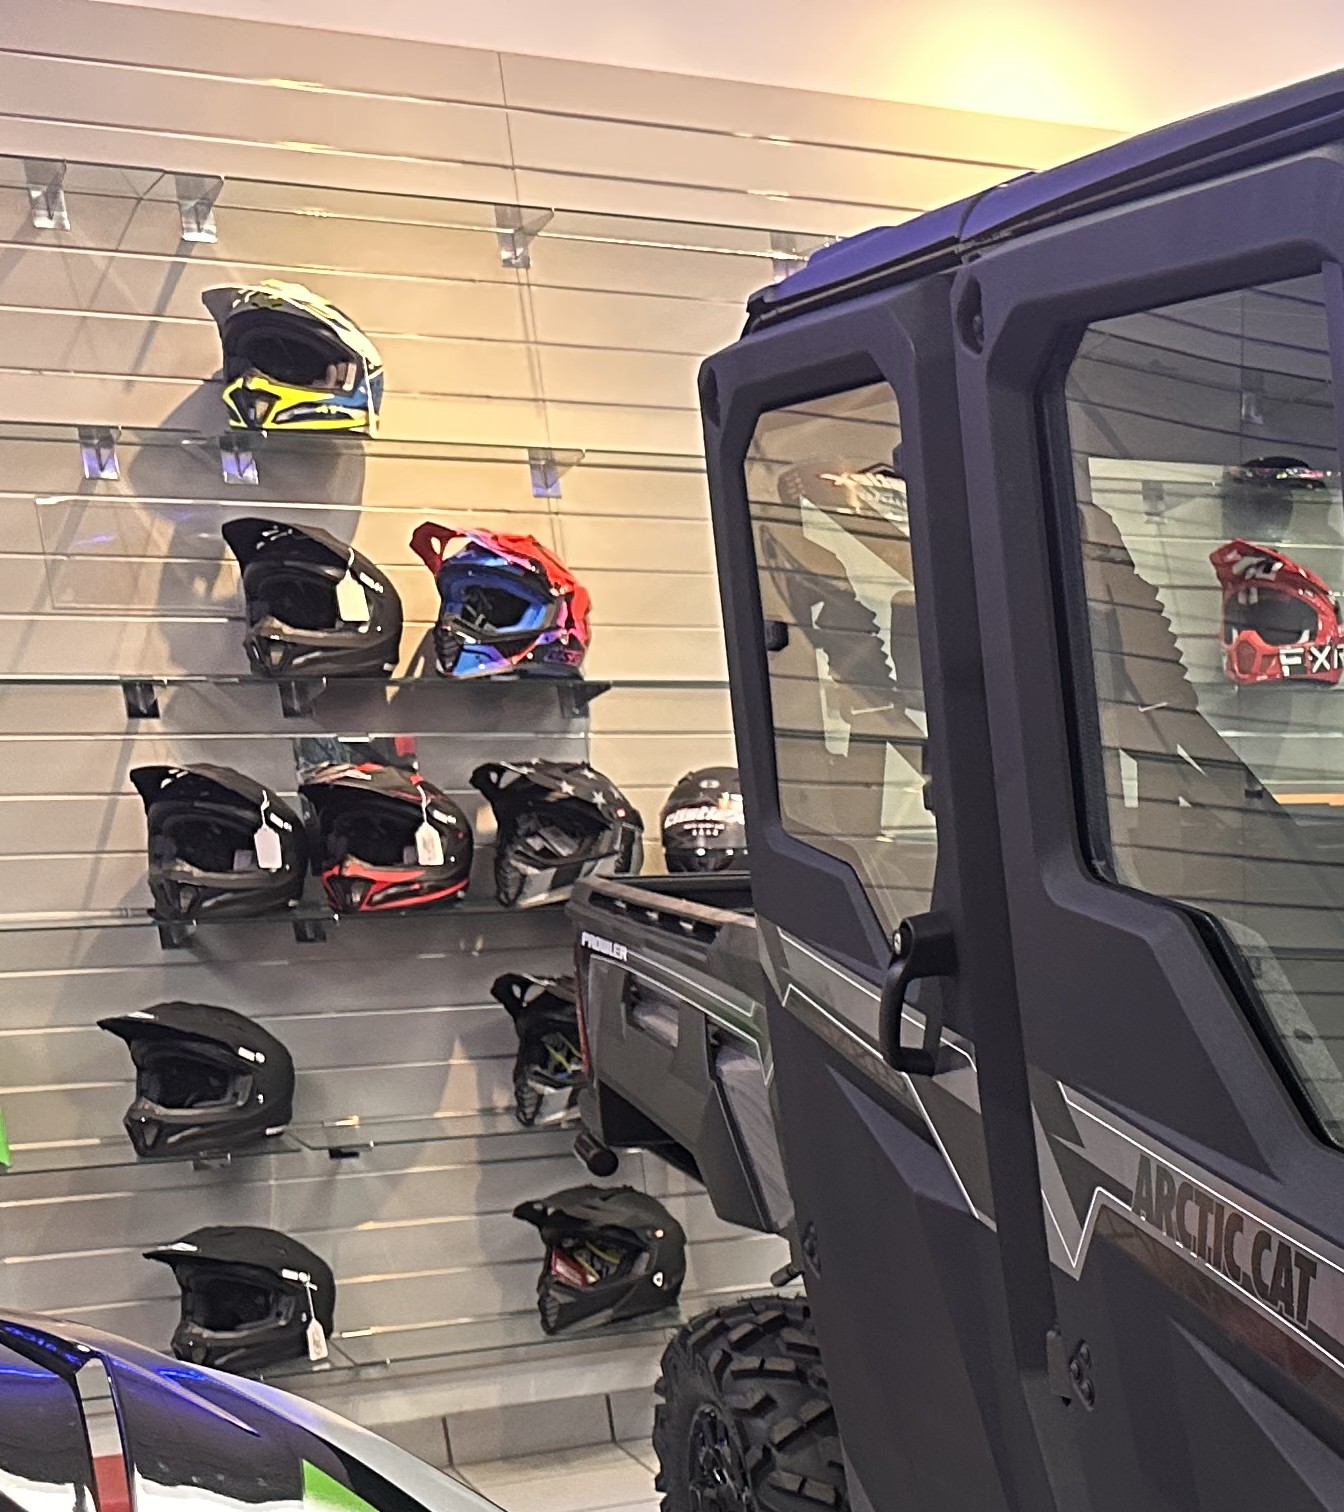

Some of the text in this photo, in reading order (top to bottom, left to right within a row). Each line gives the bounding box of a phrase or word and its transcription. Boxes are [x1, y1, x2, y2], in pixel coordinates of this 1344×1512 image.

[581, 930, 628, 963] PROWLER
[1132, 1153, 1318, 1329] ARCTIC CAT
